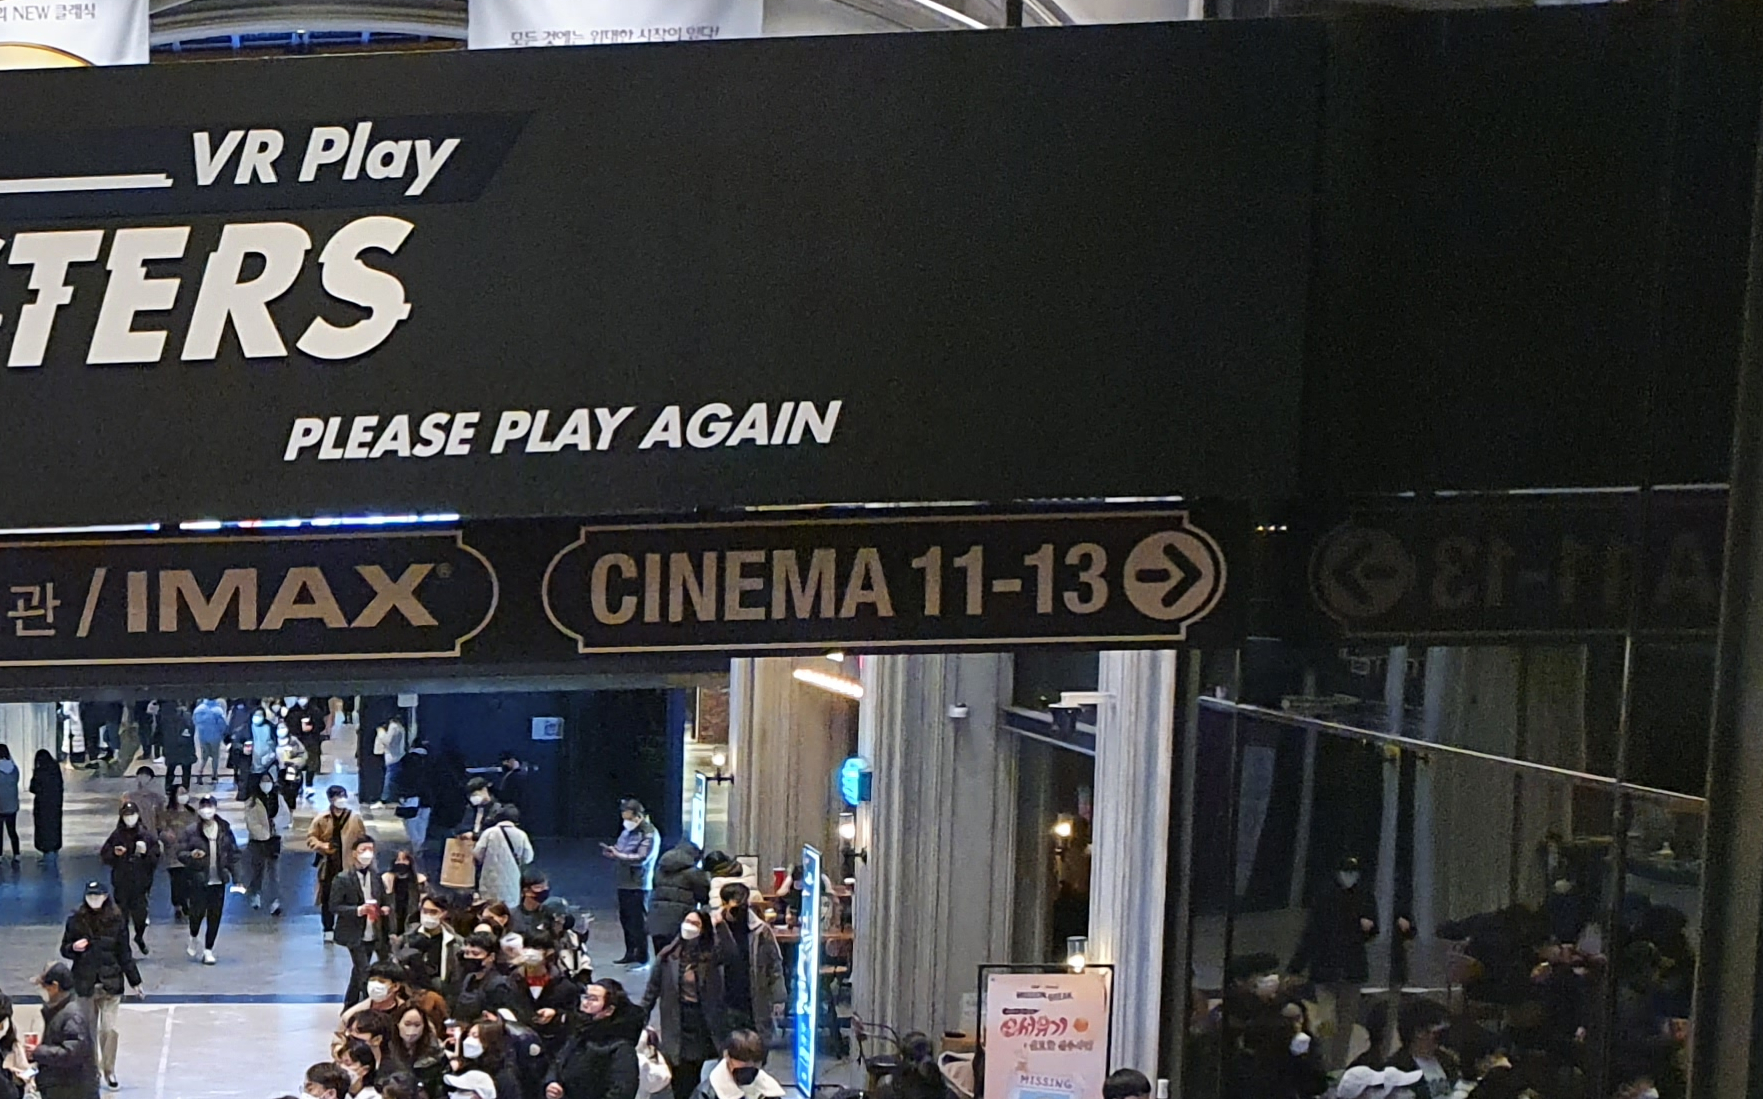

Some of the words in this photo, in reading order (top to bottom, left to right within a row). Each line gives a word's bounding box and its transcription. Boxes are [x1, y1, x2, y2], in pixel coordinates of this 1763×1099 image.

[12, 6, 52, 22] NEW
[55, 3, 97, 20] 클래식
[191, 129, 281, 187] VR
[298, 120, 462, 197] Play
[283, 410, 477, 462] PLEASE
[489, 406, 633, 455] PLAY
[638, 399, 844, 450] AGAIN
[126, 562, 440, 634] IMAX
[589, 546, 895, 626] CINEMA
[910, 541, 1109, 617] 11-13
[1020, 1074, 1074, 1090] MISSING
